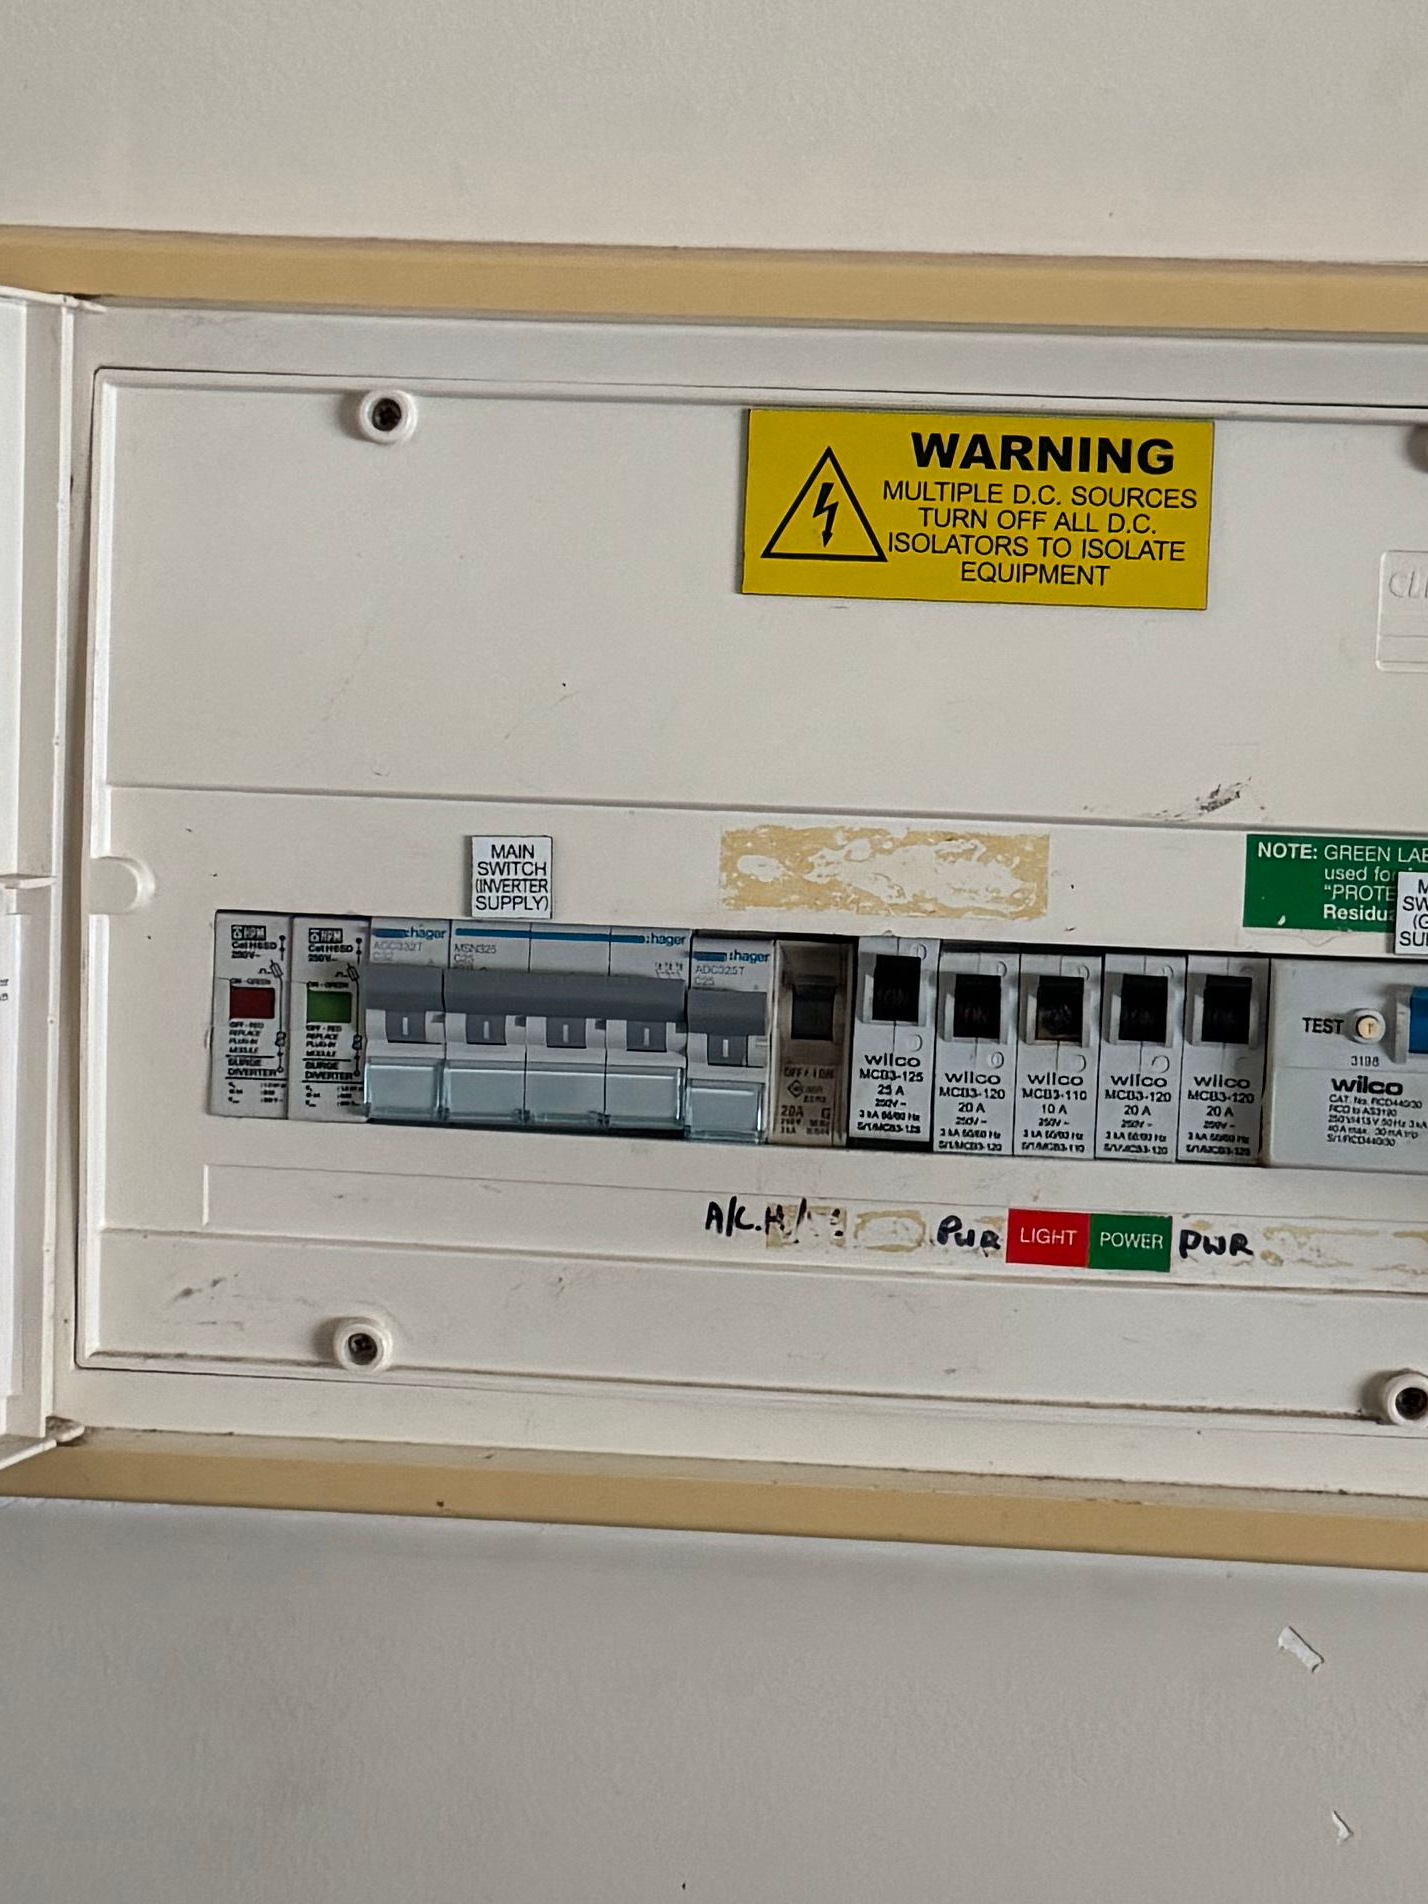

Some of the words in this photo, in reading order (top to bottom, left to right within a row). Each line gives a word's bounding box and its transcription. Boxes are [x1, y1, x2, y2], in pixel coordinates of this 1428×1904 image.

[911, 431, 1175, 476] WARNING
[883, 479, 1004, 505] MULTIPLE
[1013, 483, 1062, 507] D.C.
[1071, 485, 1198, 509] SOURCES
[918, 506, 988, 529] TURN
[996, 508, 1046, 532] OFF
[1053, 511, 1095, 533] ALL
[1105, 513, 1157, 535] D.C.
[888, 531, 1029, 558] ISOLATORS
[1036, 535, 1073, 559] TO
[1081, 537, 1186, 562] ISOLATE
[960, 560, 1112, 587] EQUIPMENT
[491, 844, 535, 859] MAIN
[1257, 841, 1318, 860] NOTE:
[1324, 844, 1391, 862] GREEN
[477, 861, 547, 876] SWITCH
[1324, 865, 1368, 882] used
[475, 878, 549, 894] (INVERTER
[475, 895, 549, 912] SUPPLY)
[1302, 1016, 1345, 1035] TEST
[864, 1053, 921, 1068] wilco
[944, 1071, 1001, 1086] wilco
[1027, 1072, 1084, 1087] wilco
[1110, 1074, 1168, 1088] wilco
[1193, 1074, 1251, 1089] wilco
[1331, 1075, 1404, 1097] wilco
[958, 1101, 974, 1113] 20
[1041, 1103, 1055, 1115] 10
[1123, 1104, 1139, 1116] 20
[1206, 1105, 1222, 1117] 20
[1019, 1226, 1078, 1247] LIGHT
[1099, 1230, 1164, 1250] POWER
